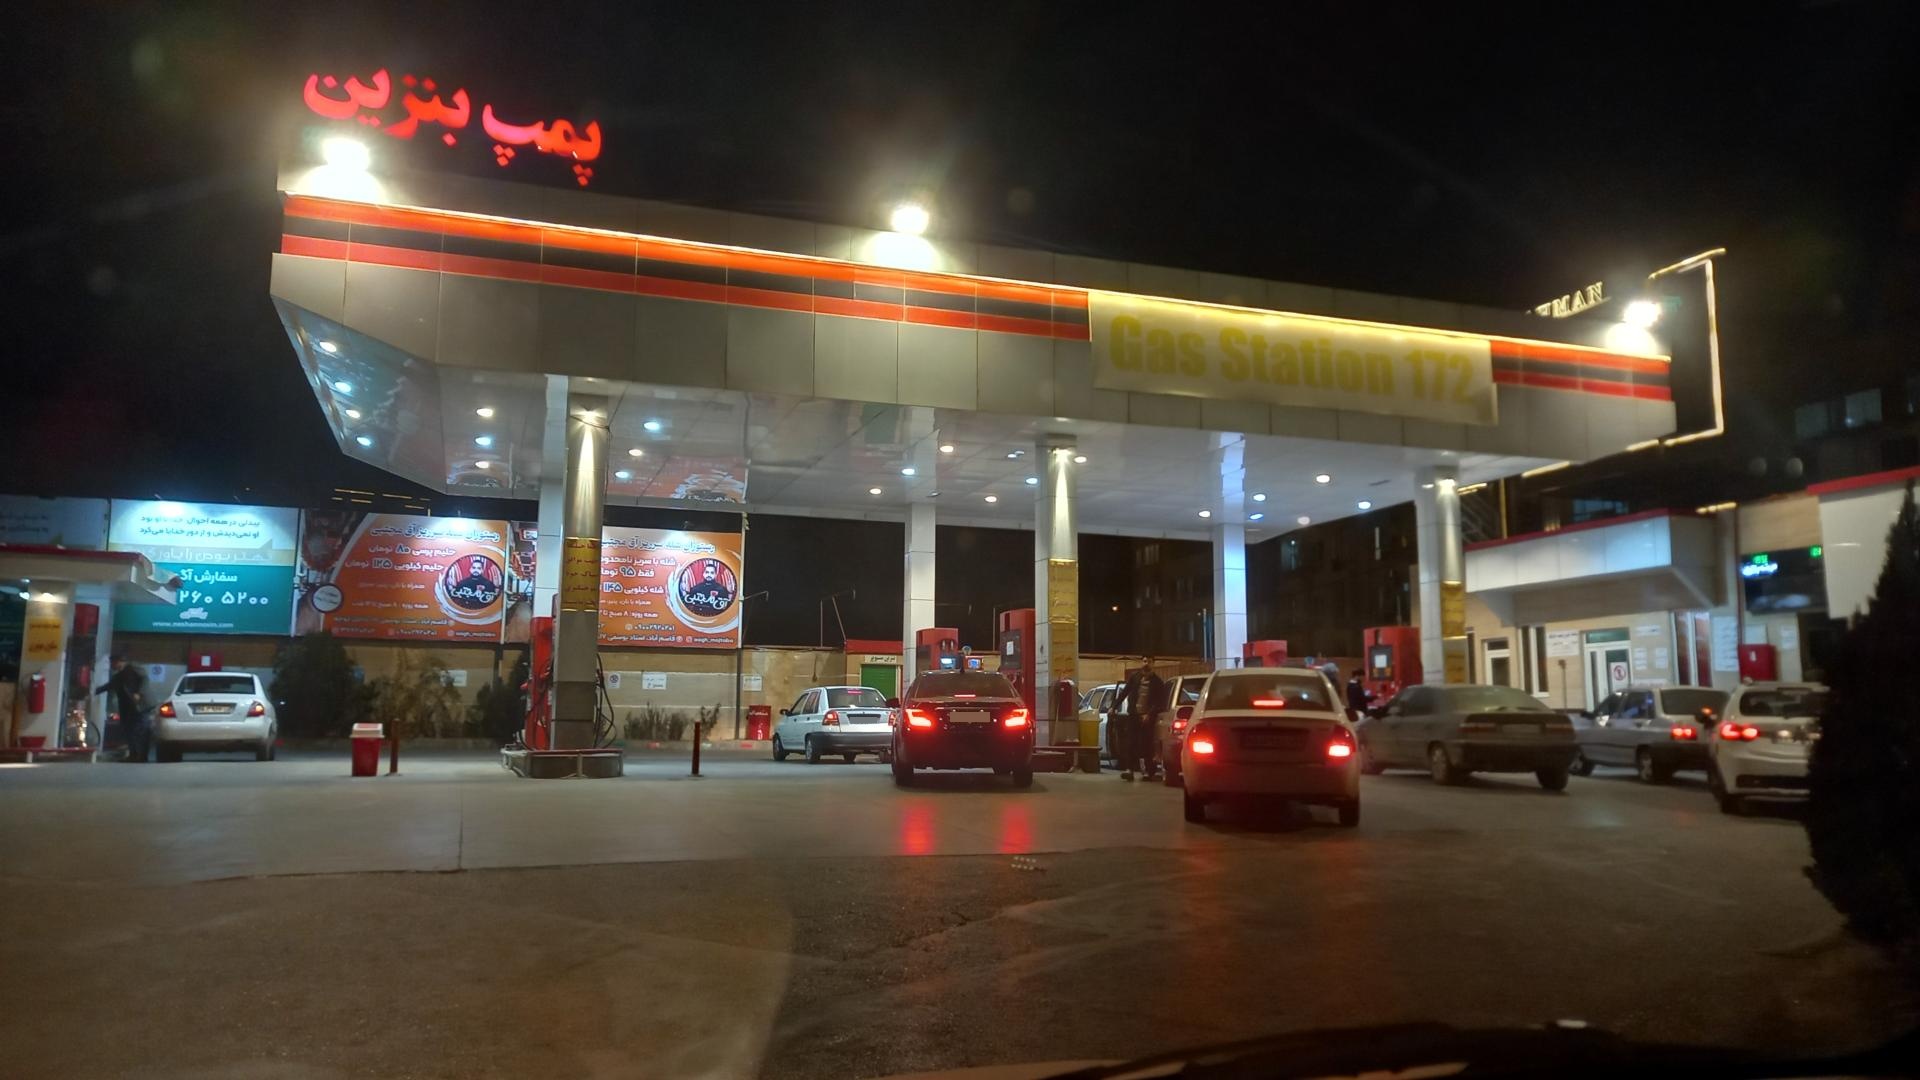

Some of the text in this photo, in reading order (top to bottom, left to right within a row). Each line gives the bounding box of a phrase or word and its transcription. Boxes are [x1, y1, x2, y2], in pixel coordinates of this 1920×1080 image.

[303, 66, 602, 187] پمپ بنزین
[1108, 314, 1474, 405] Gas Station 172
[601, 538, 627, 548] مجتب
[194, 571, 238, 585] سفارش
[601, 567, 618, 579] توما
[620, 565, 636, 578] ۹۵
[637, 568, 655, 578] فقط
